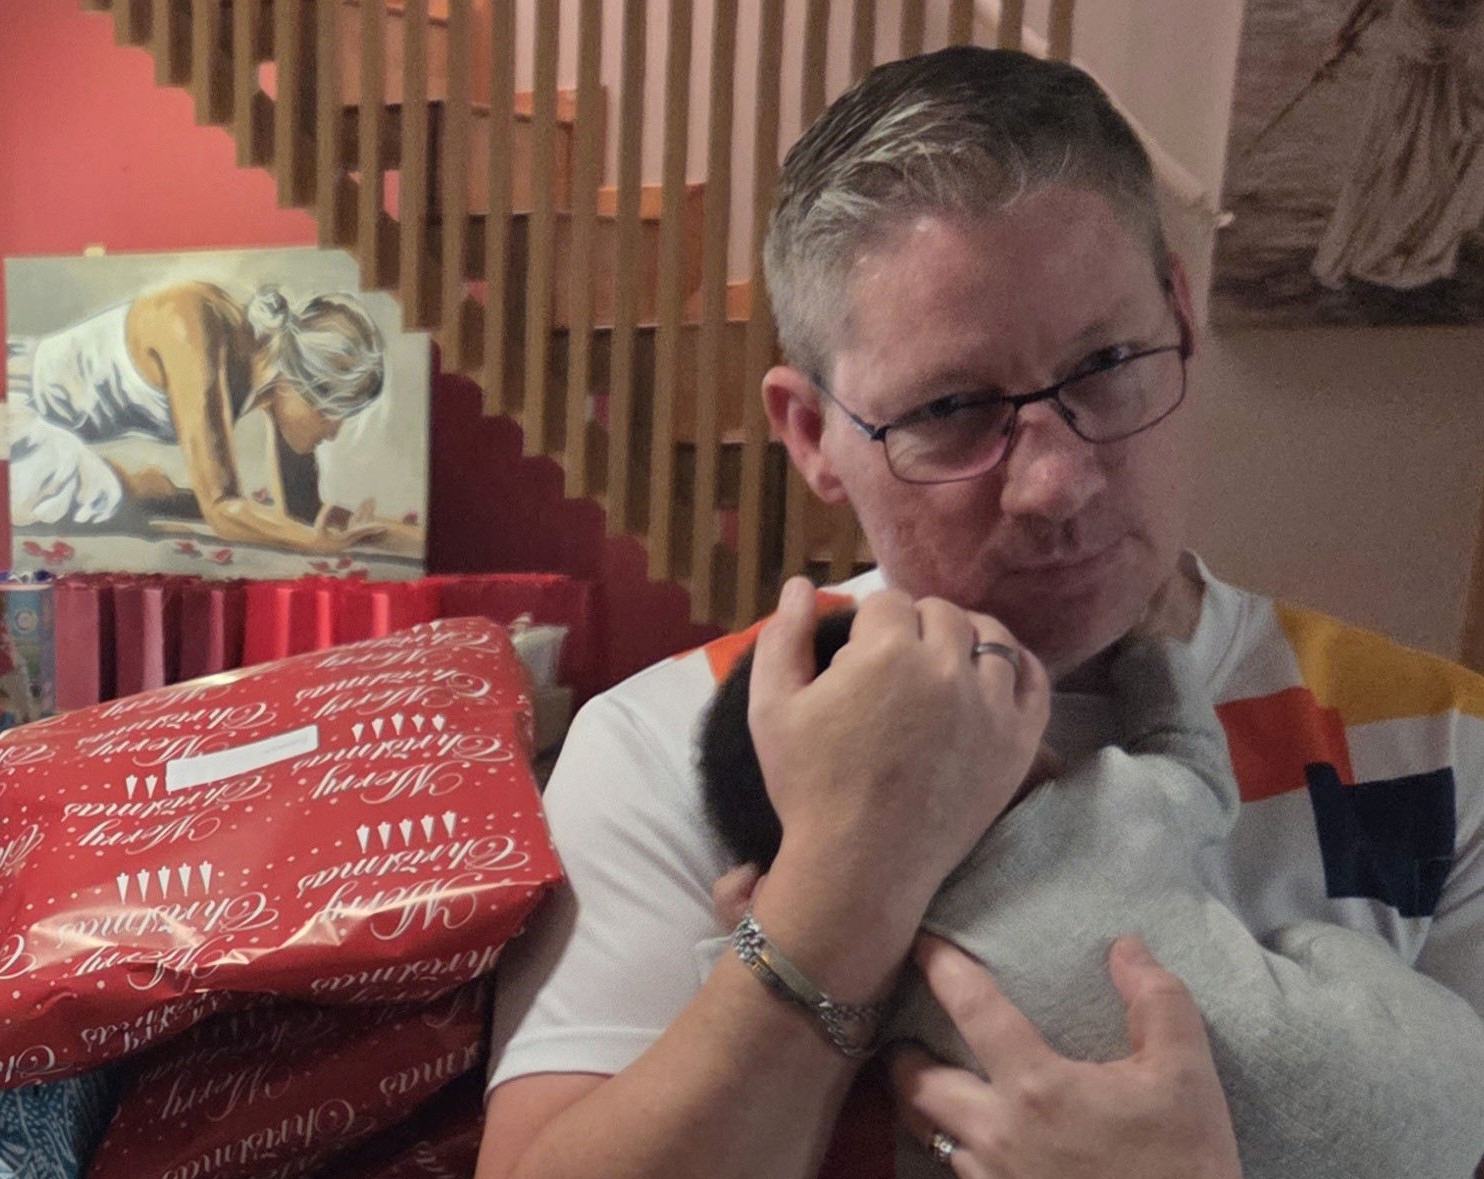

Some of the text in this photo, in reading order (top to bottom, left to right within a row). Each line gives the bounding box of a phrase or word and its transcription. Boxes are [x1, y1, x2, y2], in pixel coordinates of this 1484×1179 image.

[313, 685, 455, 719] Merry
[291, 733, 514, 777] Christmas
[309, 760, 463, 804] Merry
[78, 809, 222, 855] Merry
[296, 835, 530, 899] Christmas
[316, 872, 485, 941] Merry
